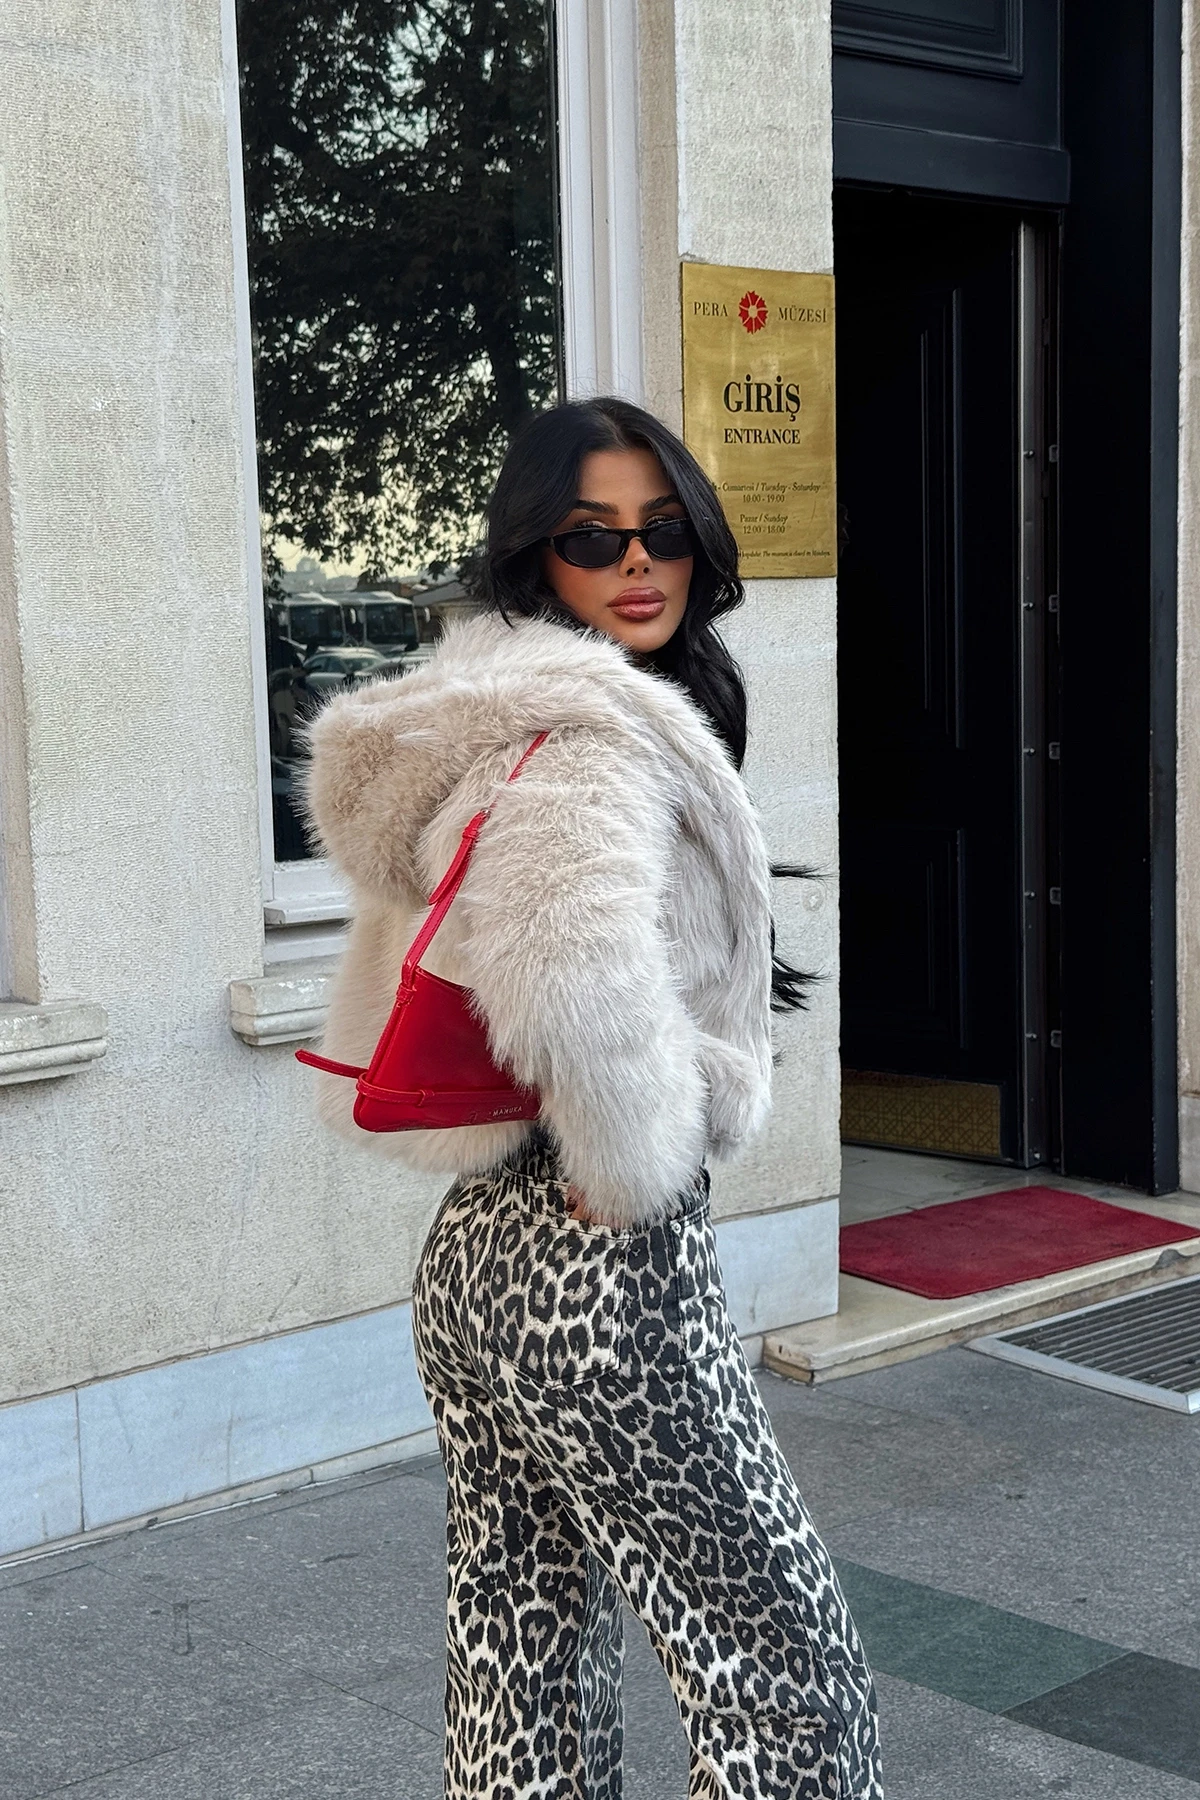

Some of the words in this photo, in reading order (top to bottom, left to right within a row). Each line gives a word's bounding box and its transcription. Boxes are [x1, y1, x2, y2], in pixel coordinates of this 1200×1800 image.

[693, 302, 728, 317] PERA
[778, 305, 827, 323] MÜZESİ
[723, 374, 801, 422] GİRİŞ
[724, 428, 801, 444] ENTRANCE
[761, 482, 788, 494] Tuesday
[792, 482, 821, 494] Saturday
[740, 514, 758, 522] Pazar
[764, 514, 788, 524] Sunday
